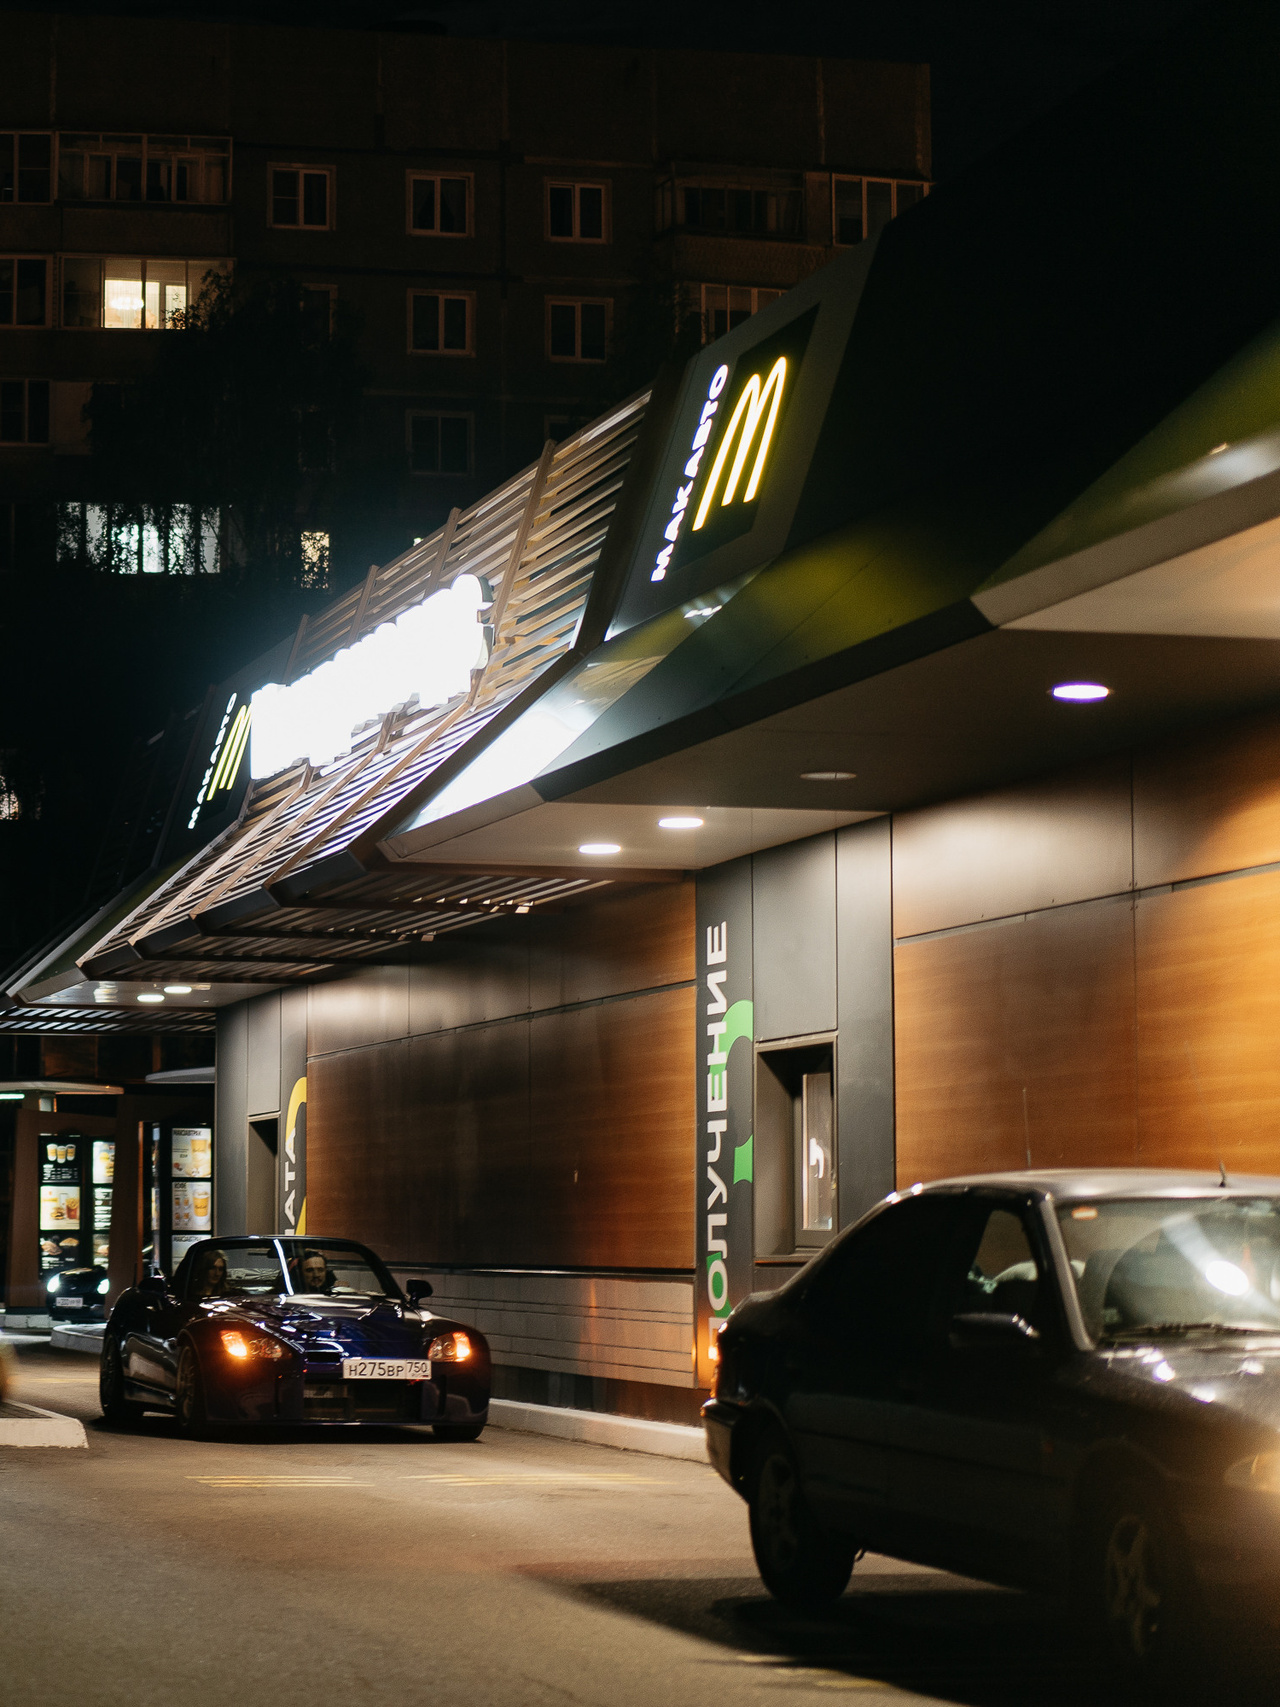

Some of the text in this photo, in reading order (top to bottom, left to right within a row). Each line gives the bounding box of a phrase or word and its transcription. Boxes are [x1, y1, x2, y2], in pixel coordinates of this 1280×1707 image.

[650, 364, 729, 582] МАКАВТО
[284, 1127, 297, 1236] АТА
[349, 1361, 428, 1377] Н275ВР 750
